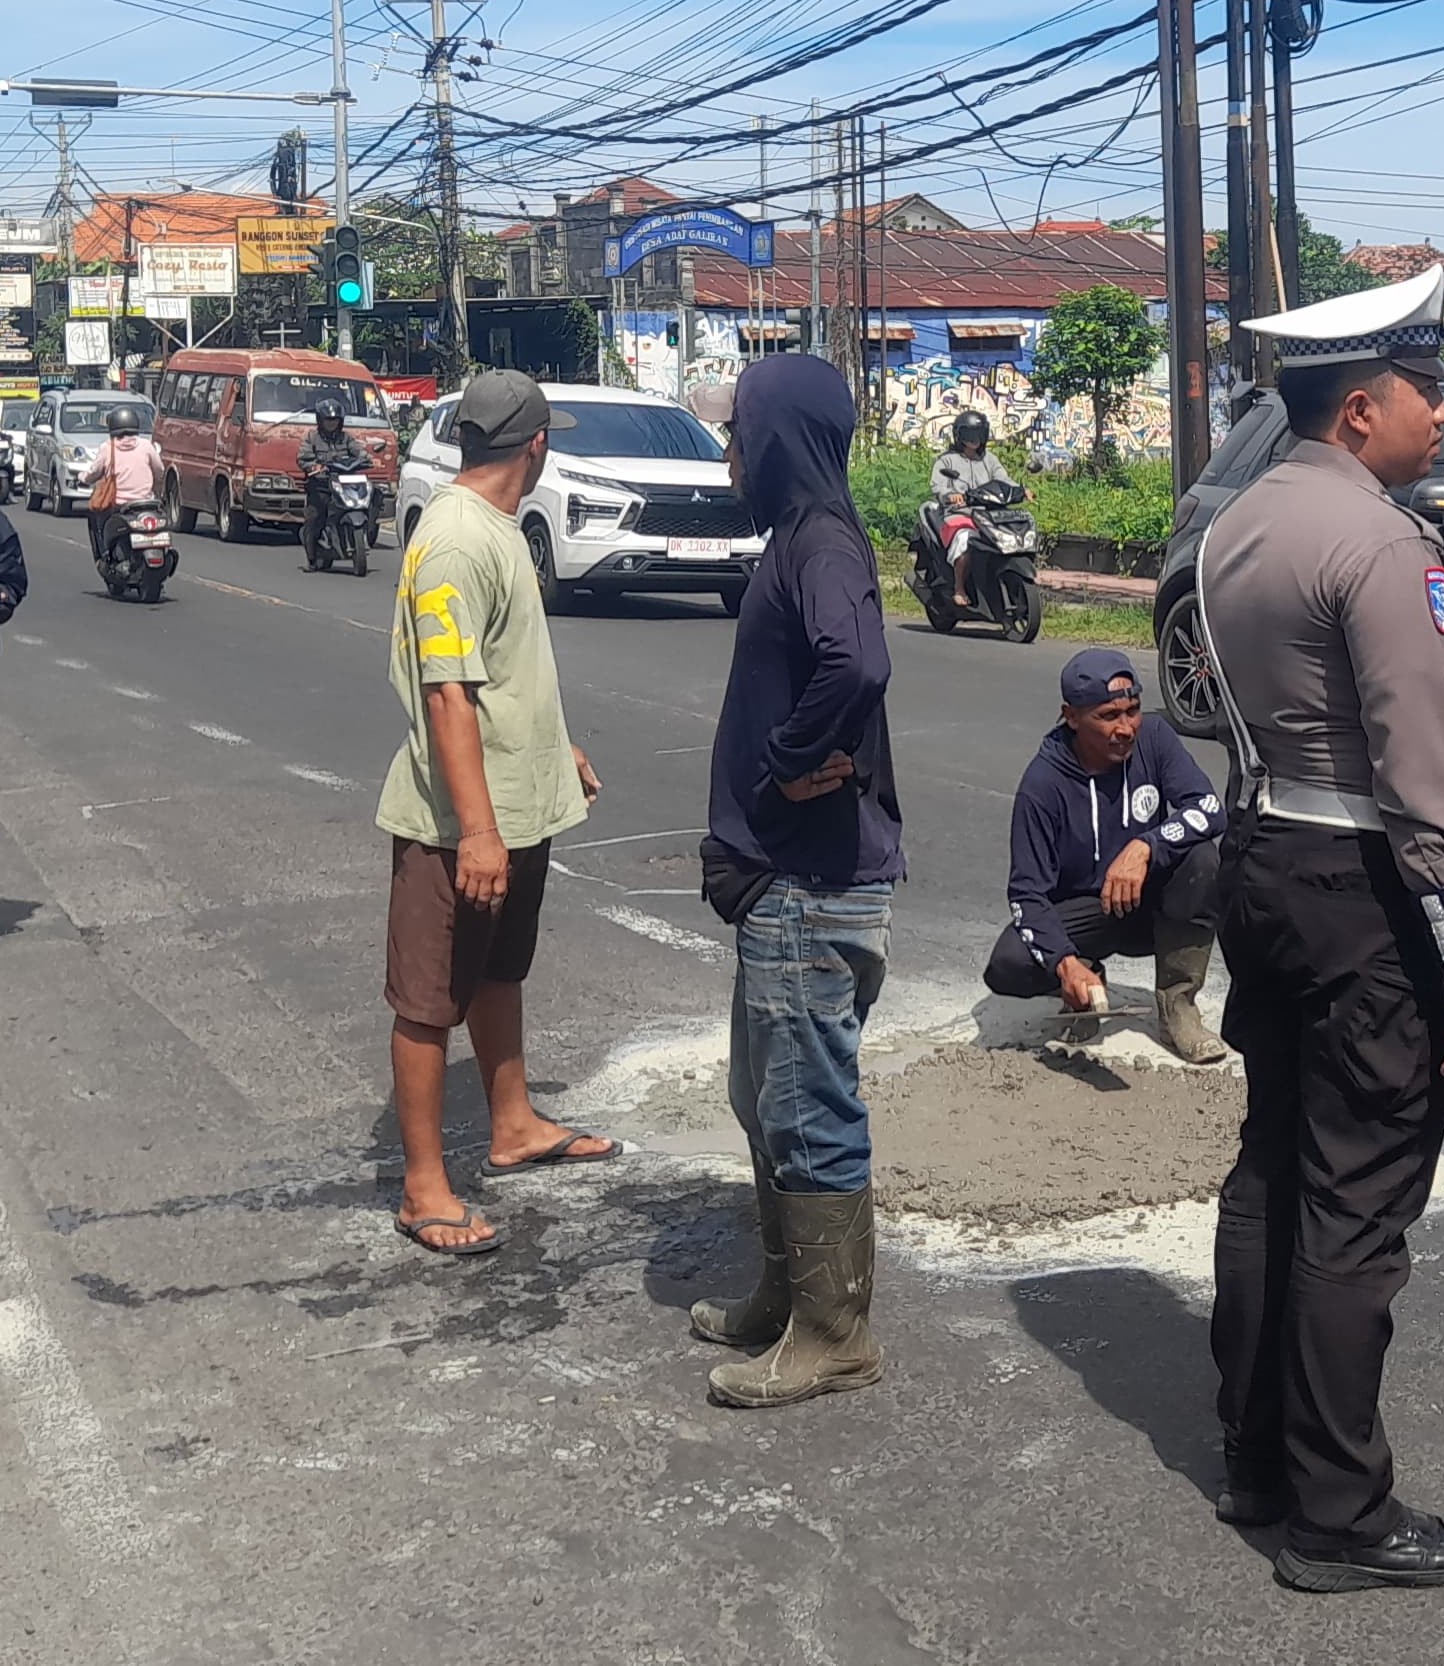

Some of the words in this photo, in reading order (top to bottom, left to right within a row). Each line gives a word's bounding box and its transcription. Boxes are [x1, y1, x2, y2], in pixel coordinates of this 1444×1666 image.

[664, 230, 686, 242] ADAT
[188, 259, 229, 271] Resto
[670, 540, 682, 552] DK
